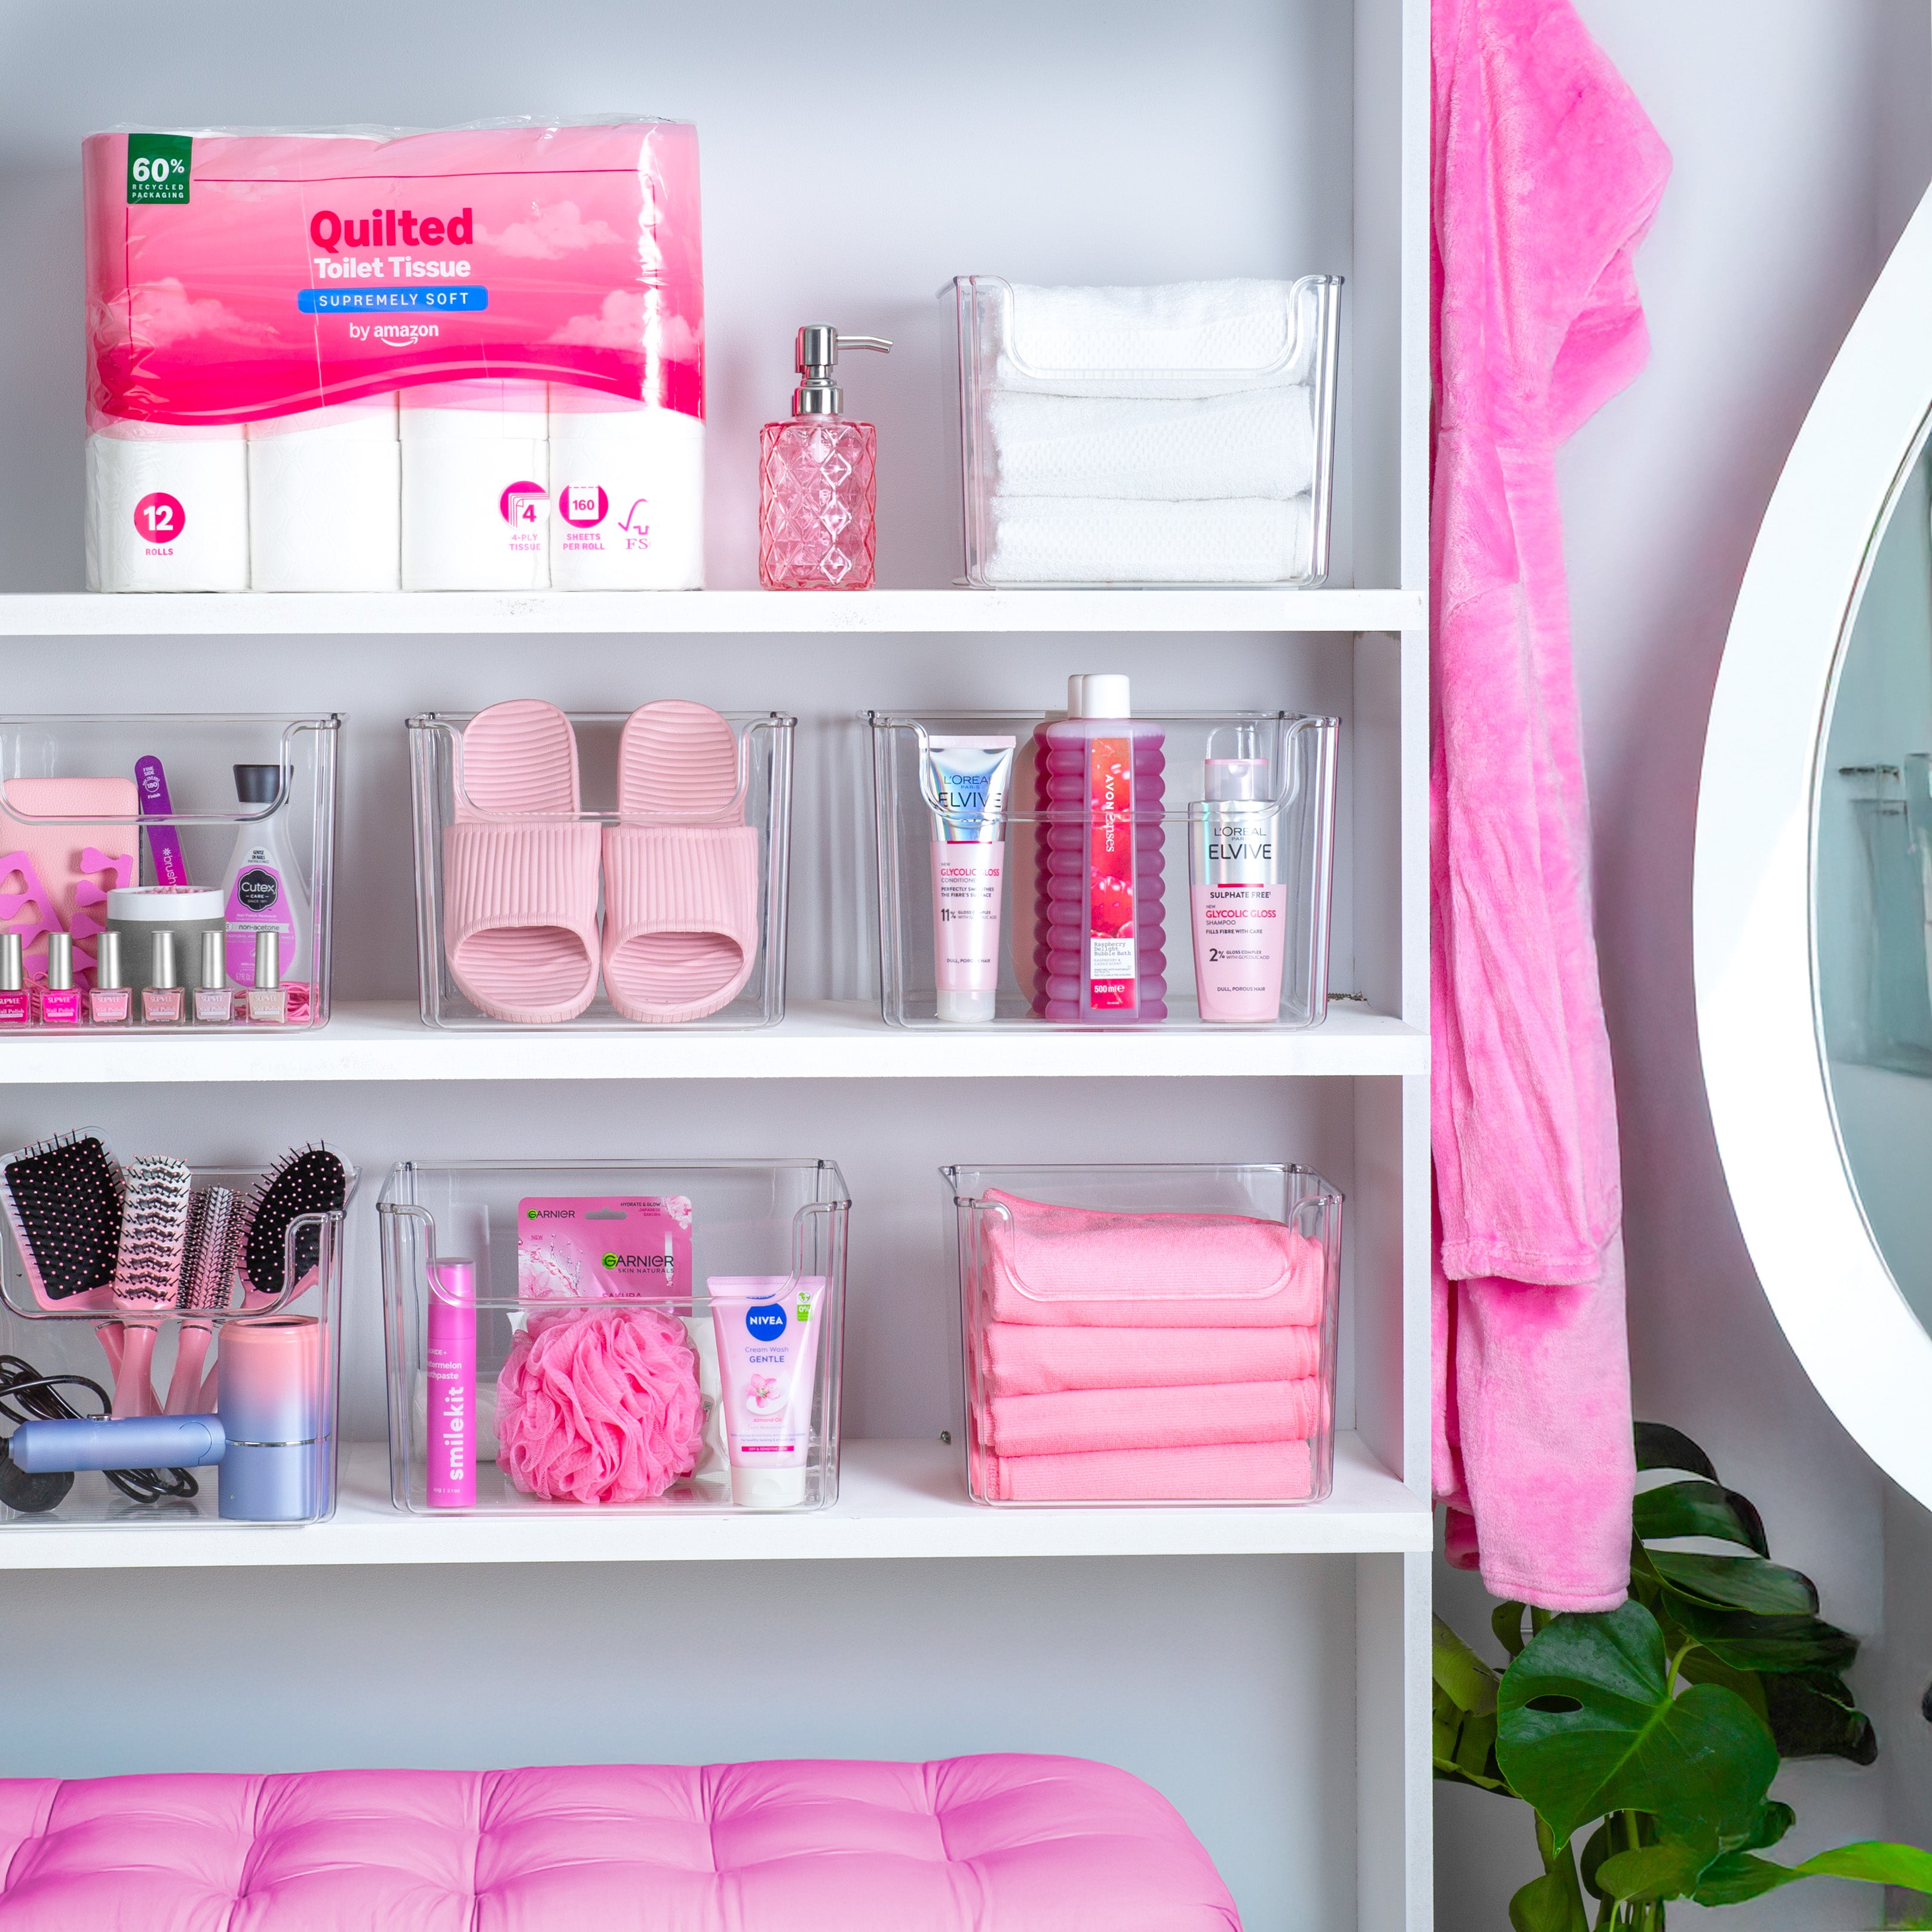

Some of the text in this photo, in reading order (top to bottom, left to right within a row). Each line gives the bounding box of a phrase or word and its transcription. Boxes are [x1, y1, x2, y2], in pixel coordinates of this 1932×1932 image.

[133, 157, 185, 182] 60%
[310, 208, 473, 253] Quilted
[314, 256, 471, 278] Toilet Tissue
[318, 292, 469, 307] SUPREMELY SOFT
[349, 322, 438, 341] by amazon
[522, 504, 536, 522] 4
[572, 499, 594, 510] 160
[143, 505, 174, 530] 12
[625, 538, 651, 550] FS
[1105, 774, 1114, 810] AVON
[1209, 844, 1271, 859] ELVIVE
[164, 855, 178, 886] brush
[241, 882, 275, 893] Cutex
[941, 909, 956, 921] 11%
[1209, 948, 1225, 962] 2%
[750, 1316, 783, 1325] NIVEA
[443, 1387, 464, 1480] smilekit
